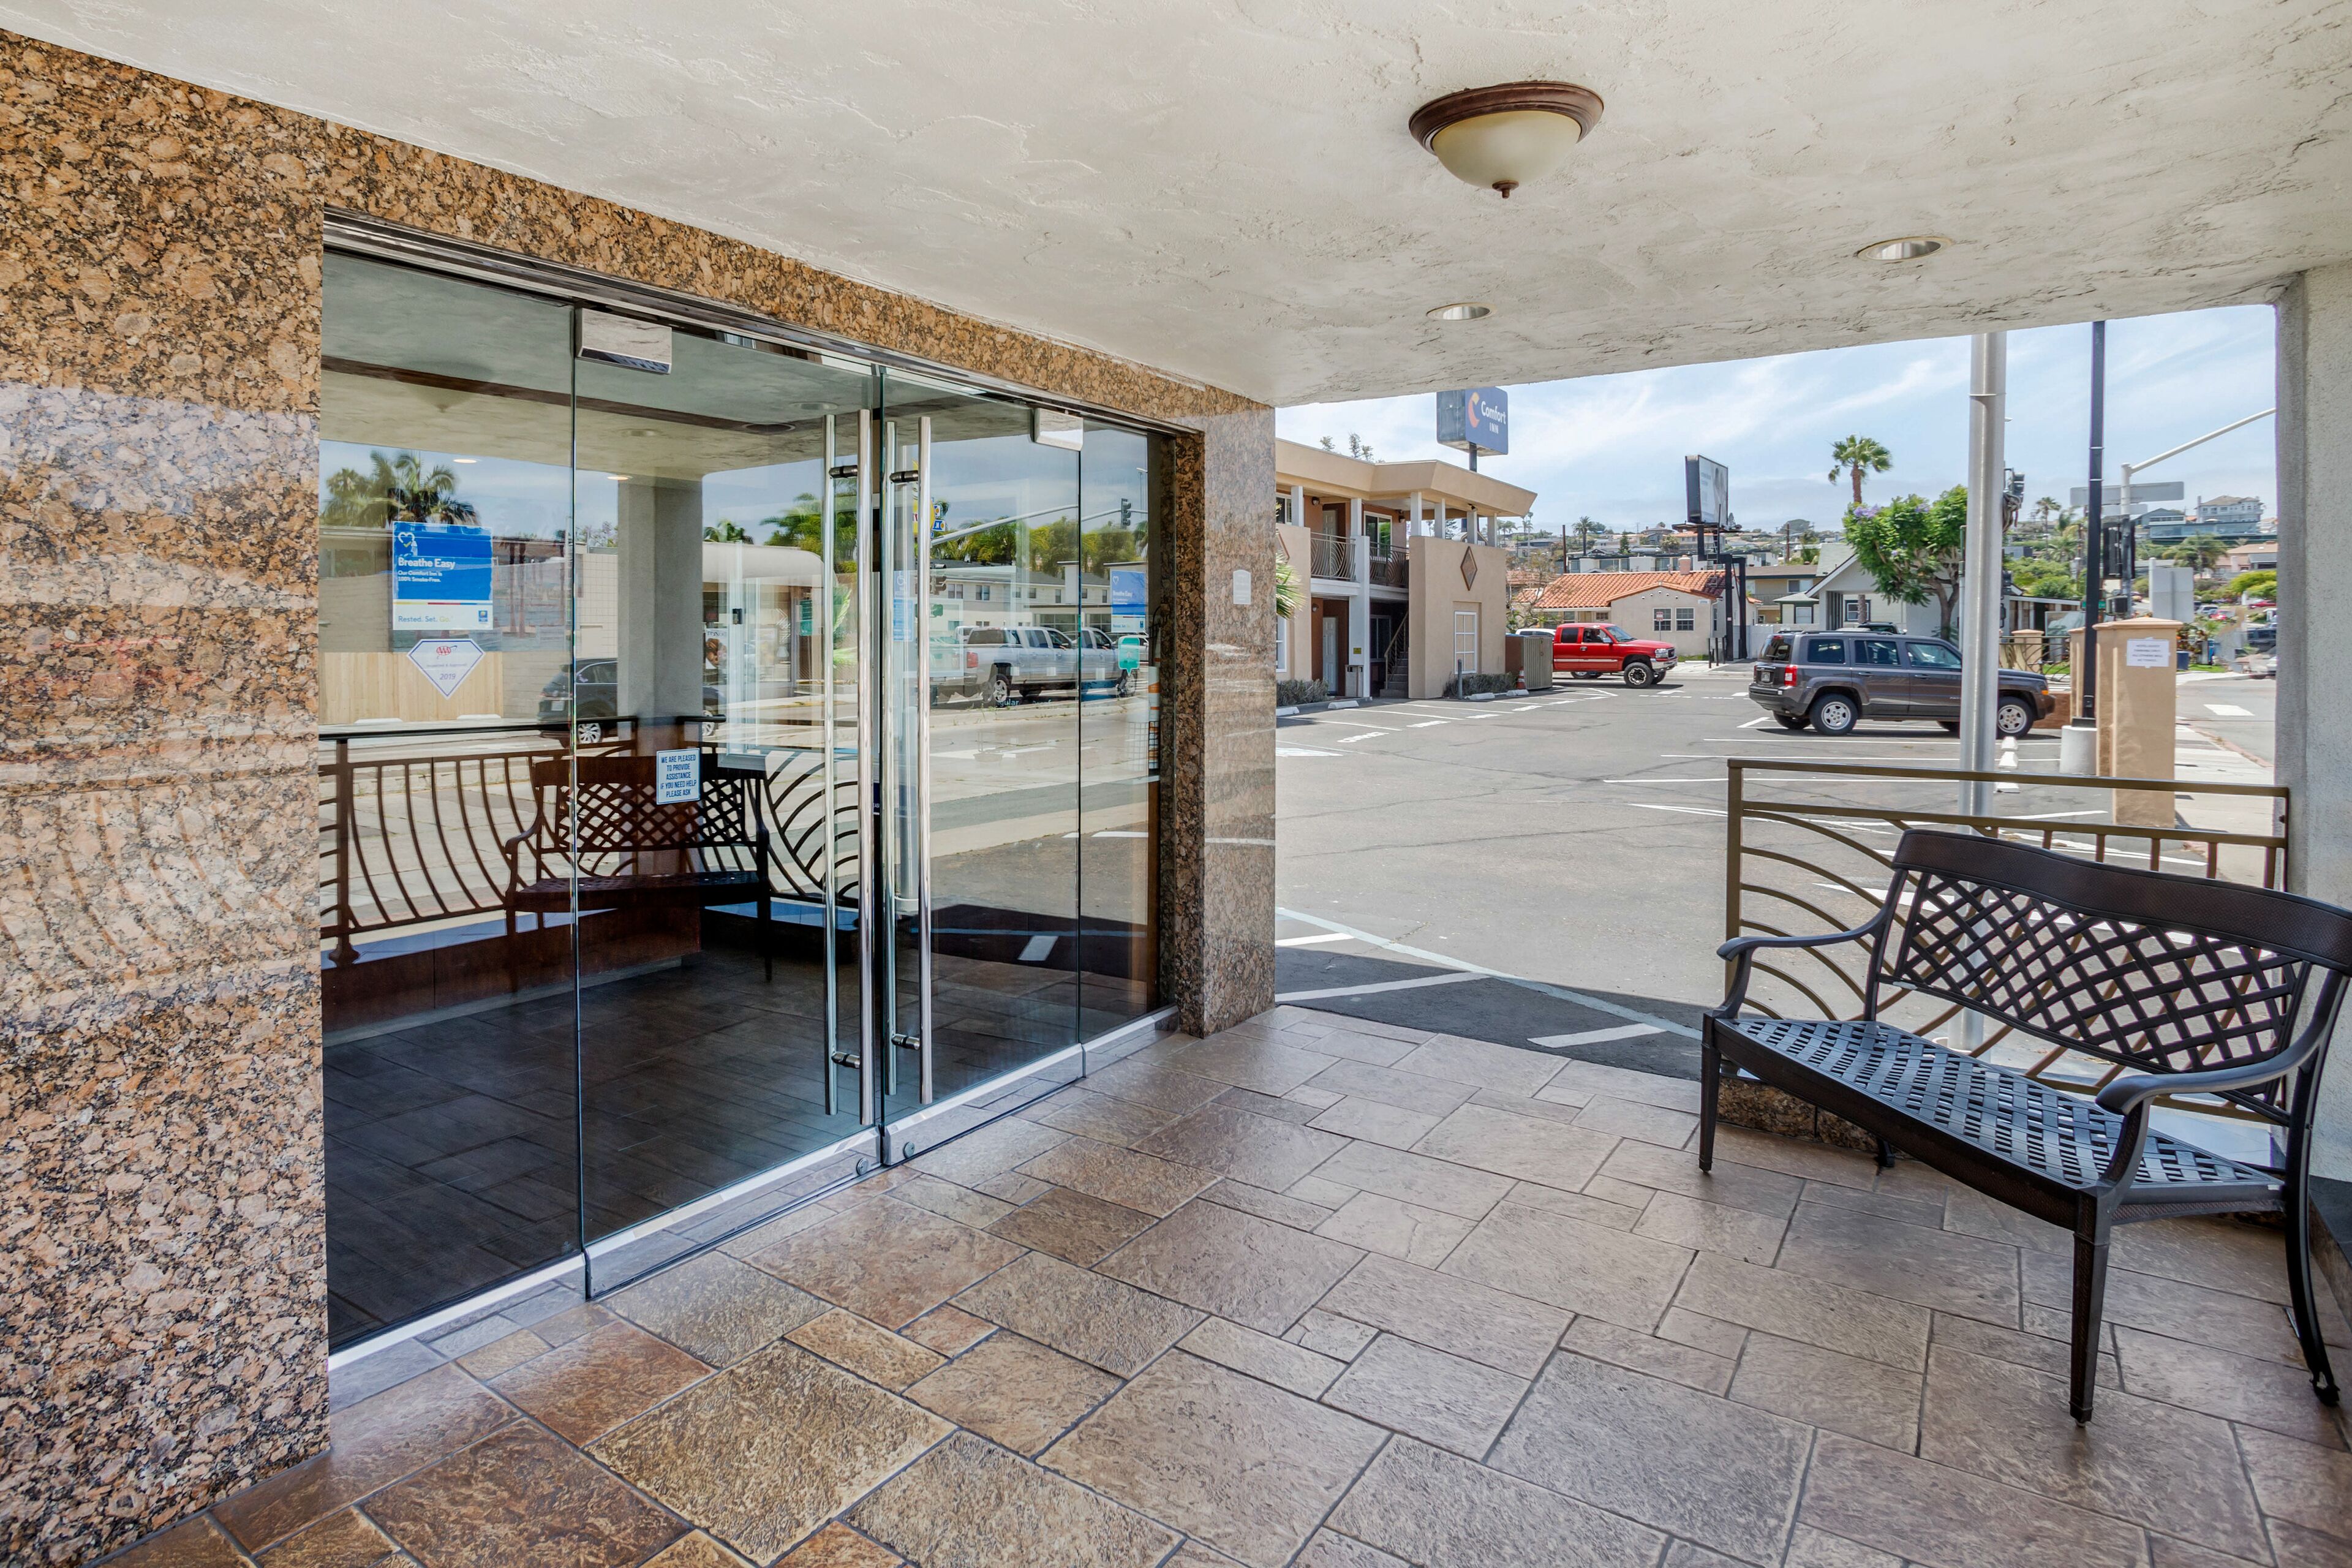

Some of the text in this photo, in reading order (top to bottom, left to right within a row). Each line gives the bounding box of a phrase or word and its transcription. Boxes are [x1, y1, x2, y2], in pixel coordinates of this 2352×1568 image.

[1481, 401, 1506, 424] Comfort
[1489, 422, 1499, 434] INN
[398, 557, 456, 570] Breathe Easy
[437, 646, 451, 655] AAA
